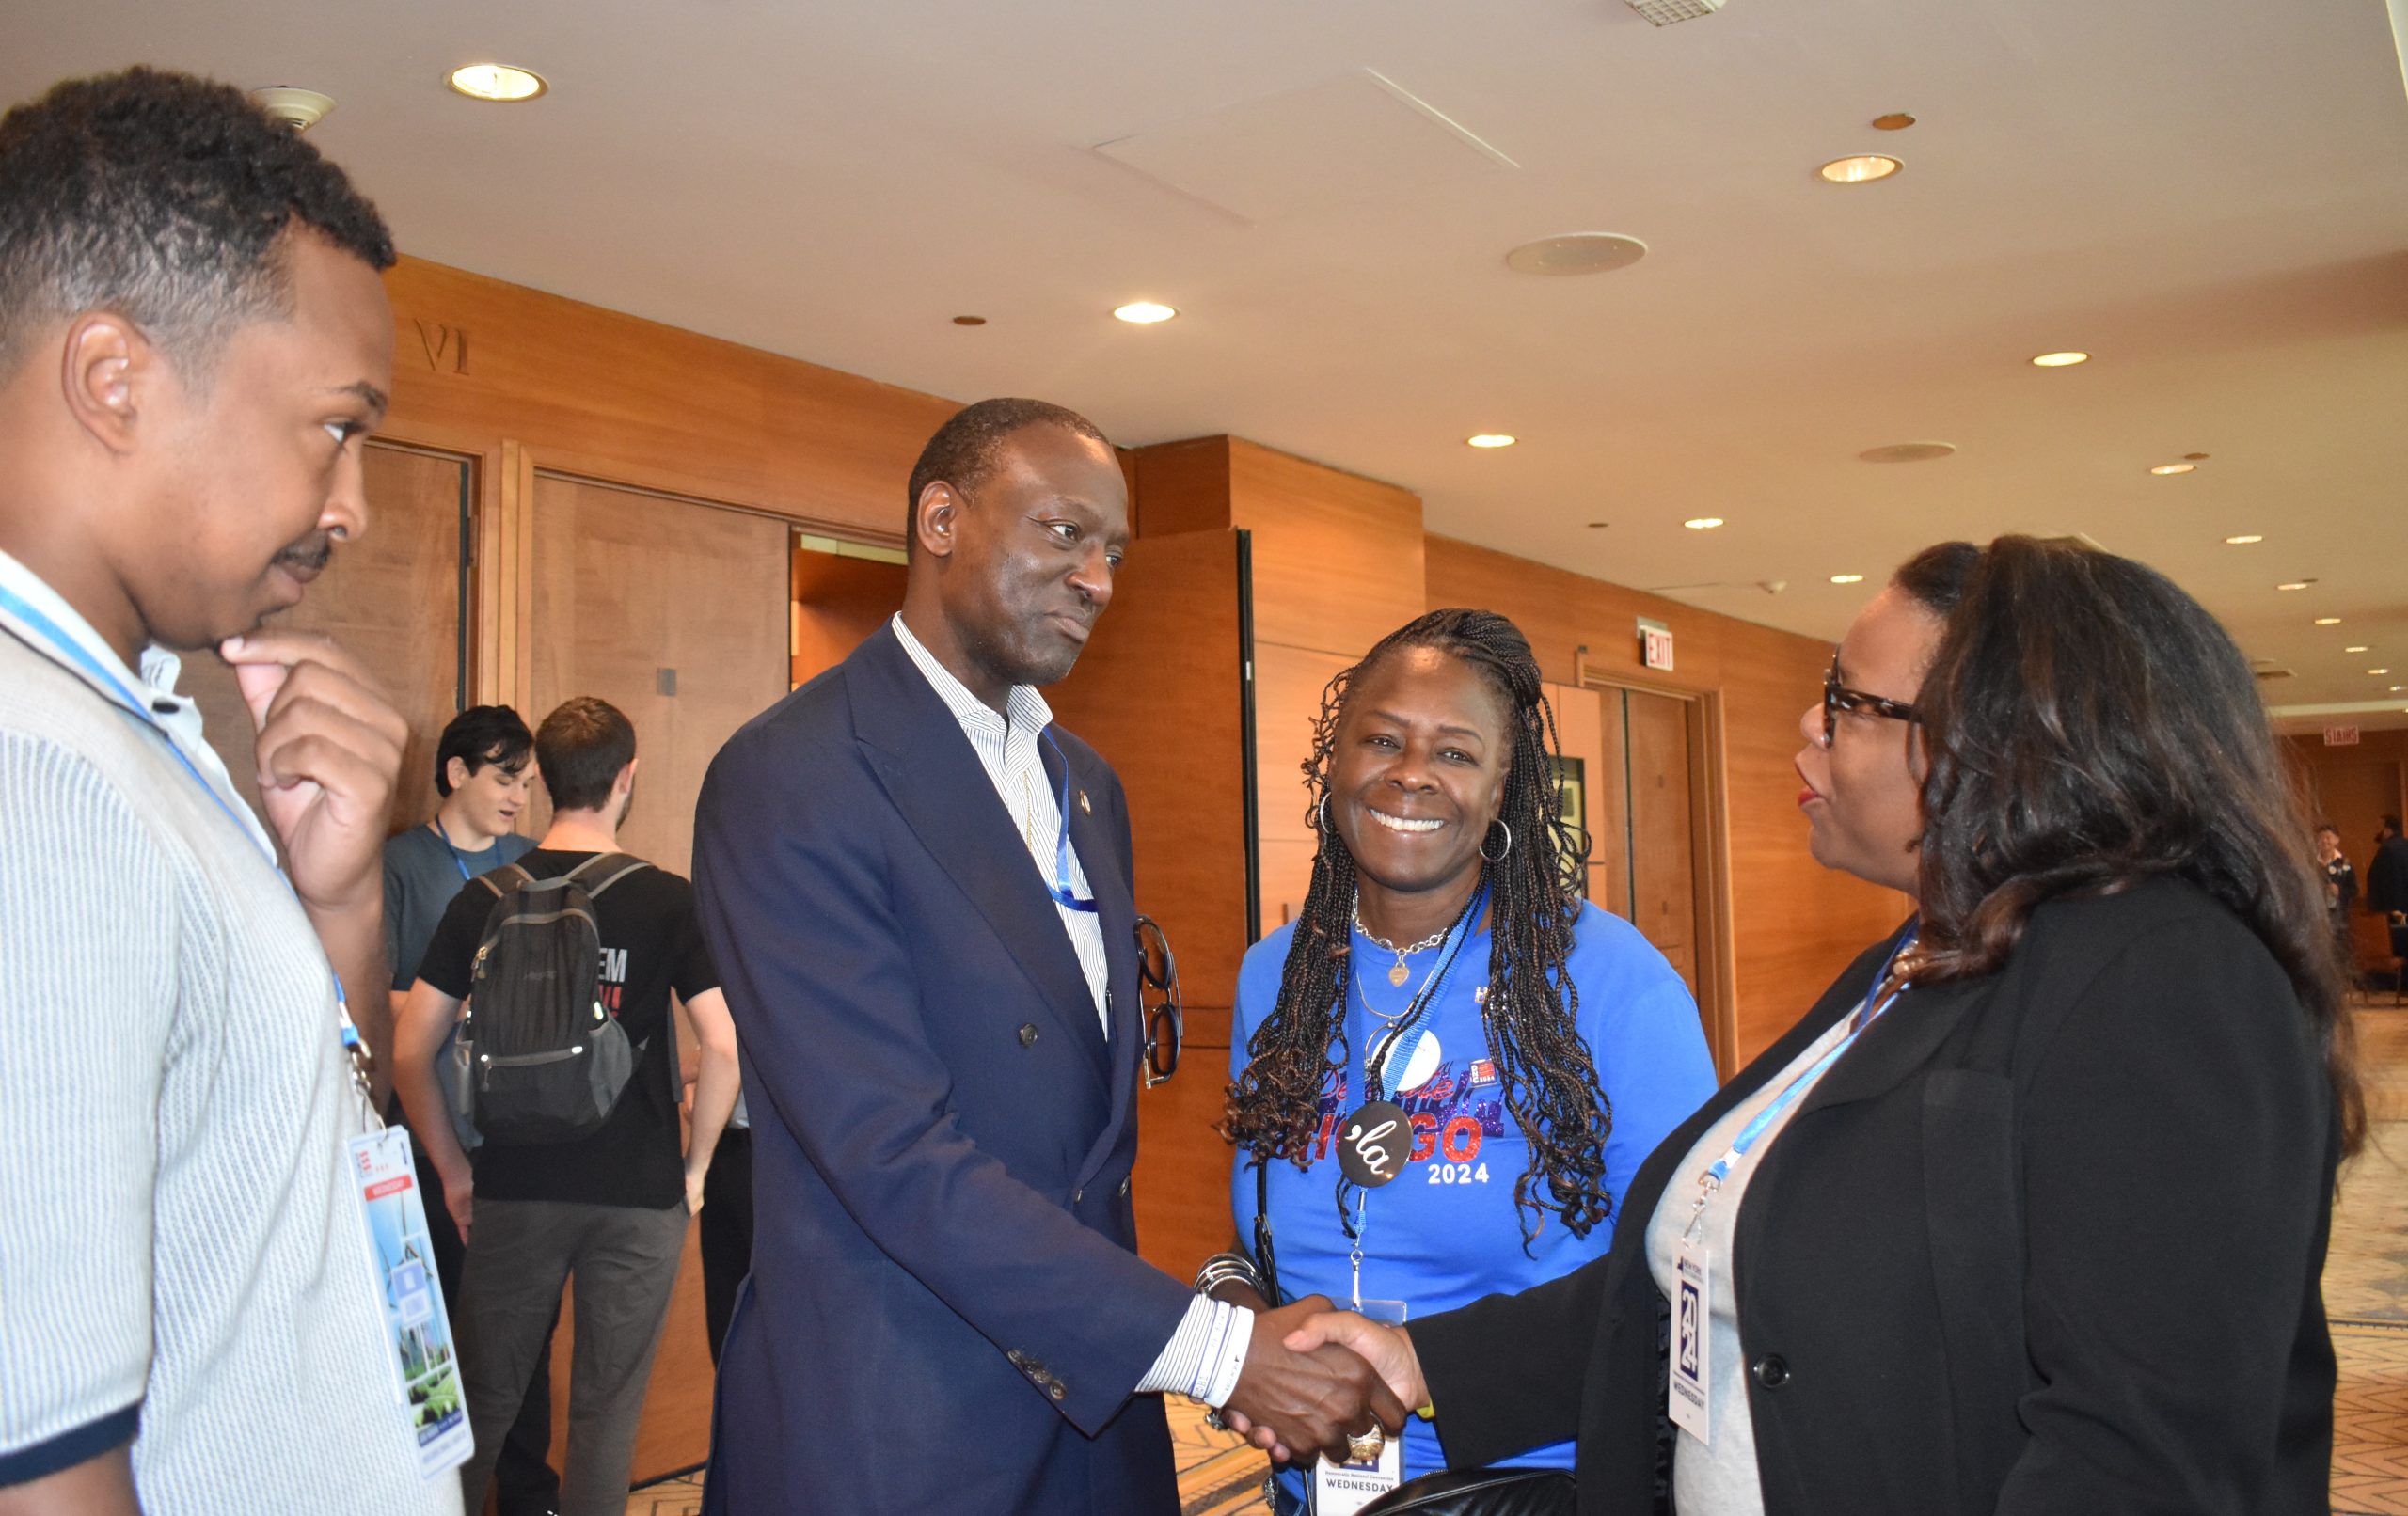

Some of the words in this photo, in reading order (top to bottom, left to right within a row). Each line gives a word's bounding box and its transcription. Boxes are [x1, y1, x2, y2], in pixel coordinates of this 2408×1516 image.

[414, 318, 469, 376] VI
[1649, 633, 1671, 667] EXIT
[2325, 728, 2357, 743] STAIRS
[1428, 1163, 1490, 1184] 2024
[1673, 1382, 1704, 1410] WEDNESDAY
[1326, 1478, 1392, 1492] WEDNESDAY
